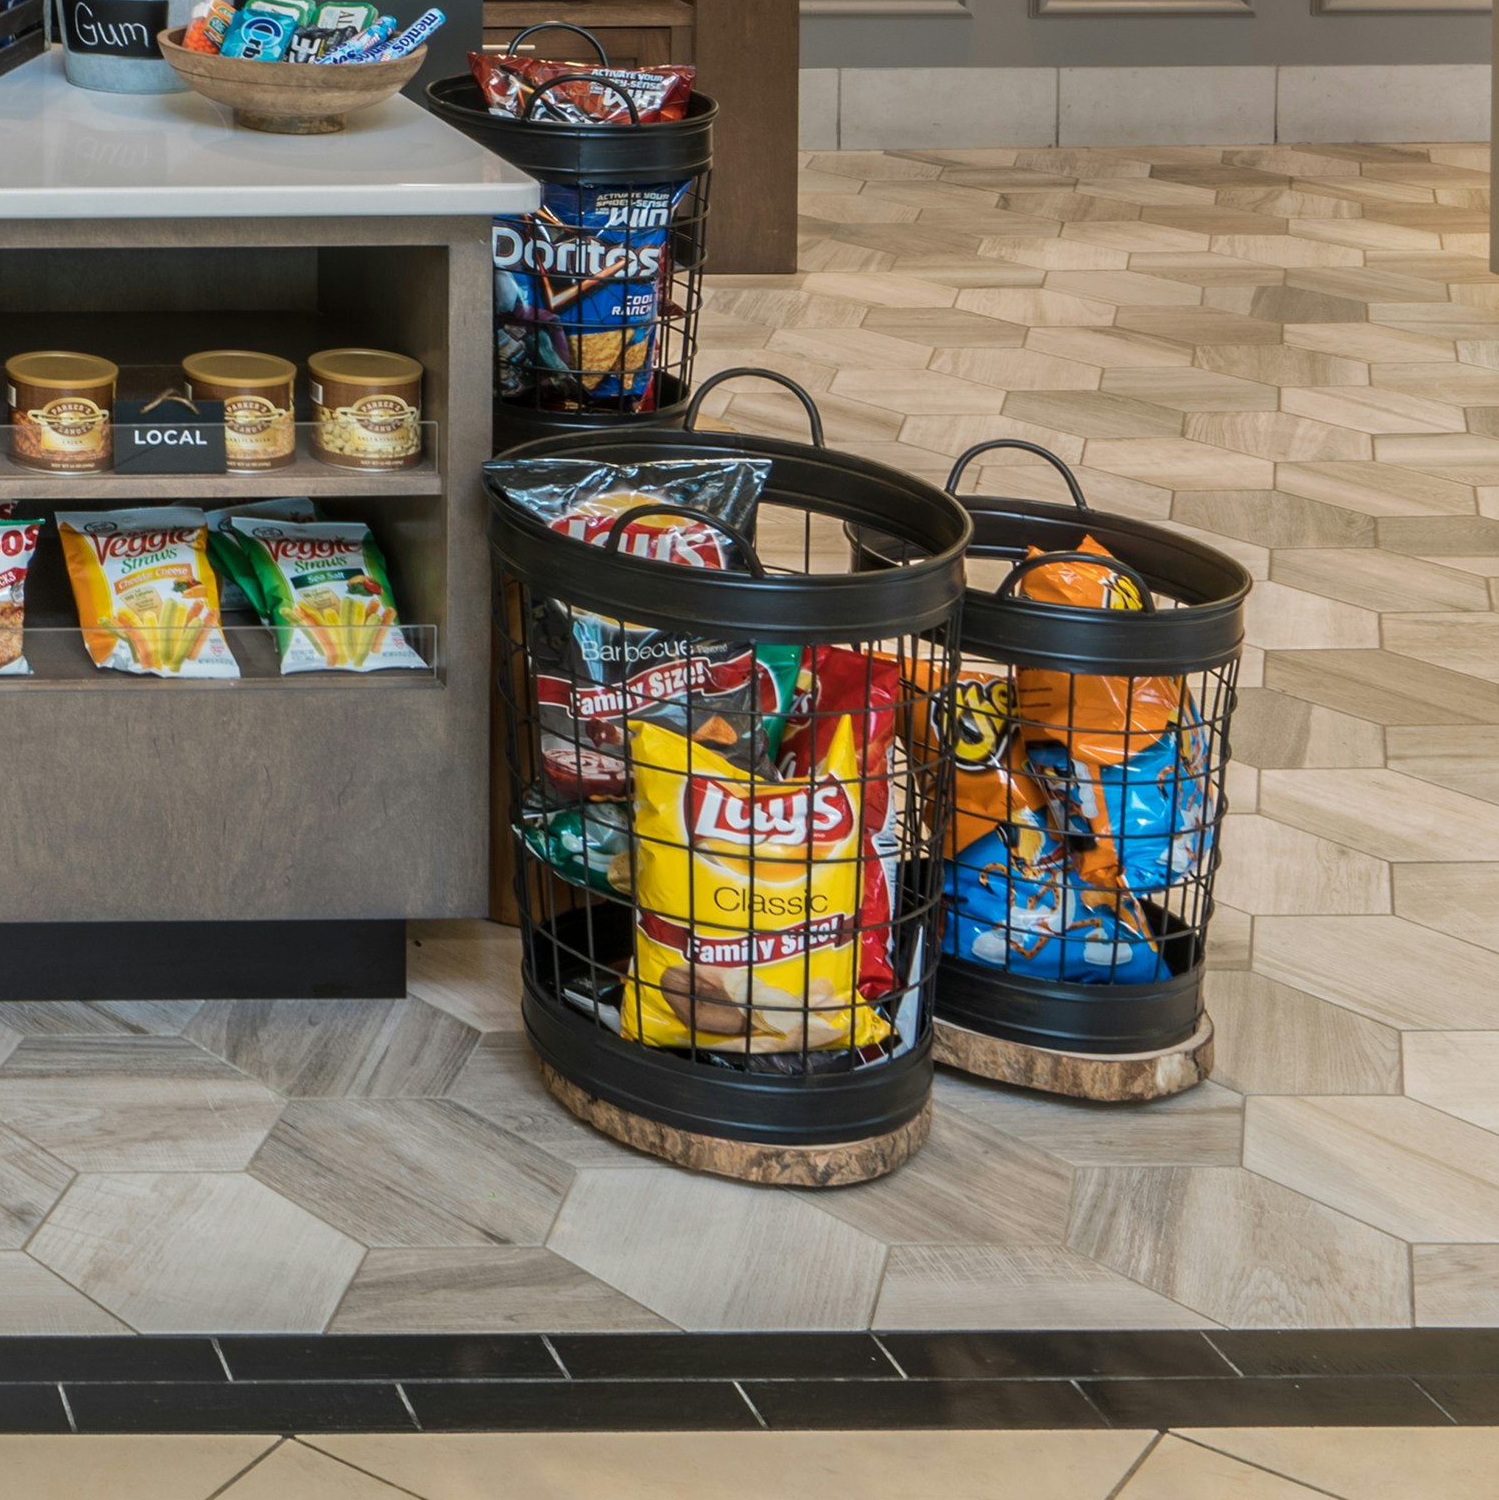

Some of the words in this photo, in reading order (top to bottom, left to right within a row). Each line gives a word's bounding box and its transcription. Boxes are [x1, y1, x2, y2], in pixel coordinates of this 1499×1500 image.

[74, 1, 150, 49] Gum
[389, 10, 441, 56] mentos
[591, 68, 637, 79] ACTIVATE
[637, 71, 665, 82] YOUR
[596, 192, 642, 201] ACTIVATE
[643, 192, 670, 201] YOUR
[492, 225, 663, 279] Doritos
[51, 402, 92, 415] PARKER'S
[360, 400, 401, 412] PARKER'S
[134, 429, 207, 446] LOCAL
[89, 528, 198, 566] Veggie
[261, 537, 362, 563] Veggie
[121, 547, 179, 575] Straws
[294, 555, 347, 575] Straws
[118, 571, 154, 590] Cheddar
[155, 565, 189, 578] Cheese
[307, 573, 326, 584] Sea
[326, 571, 345, 582] Salt
[581, 639, 688, 663] Barbecue
[650, 661, 705, 694] Size!
[713, 886, 829, 916] Classic
